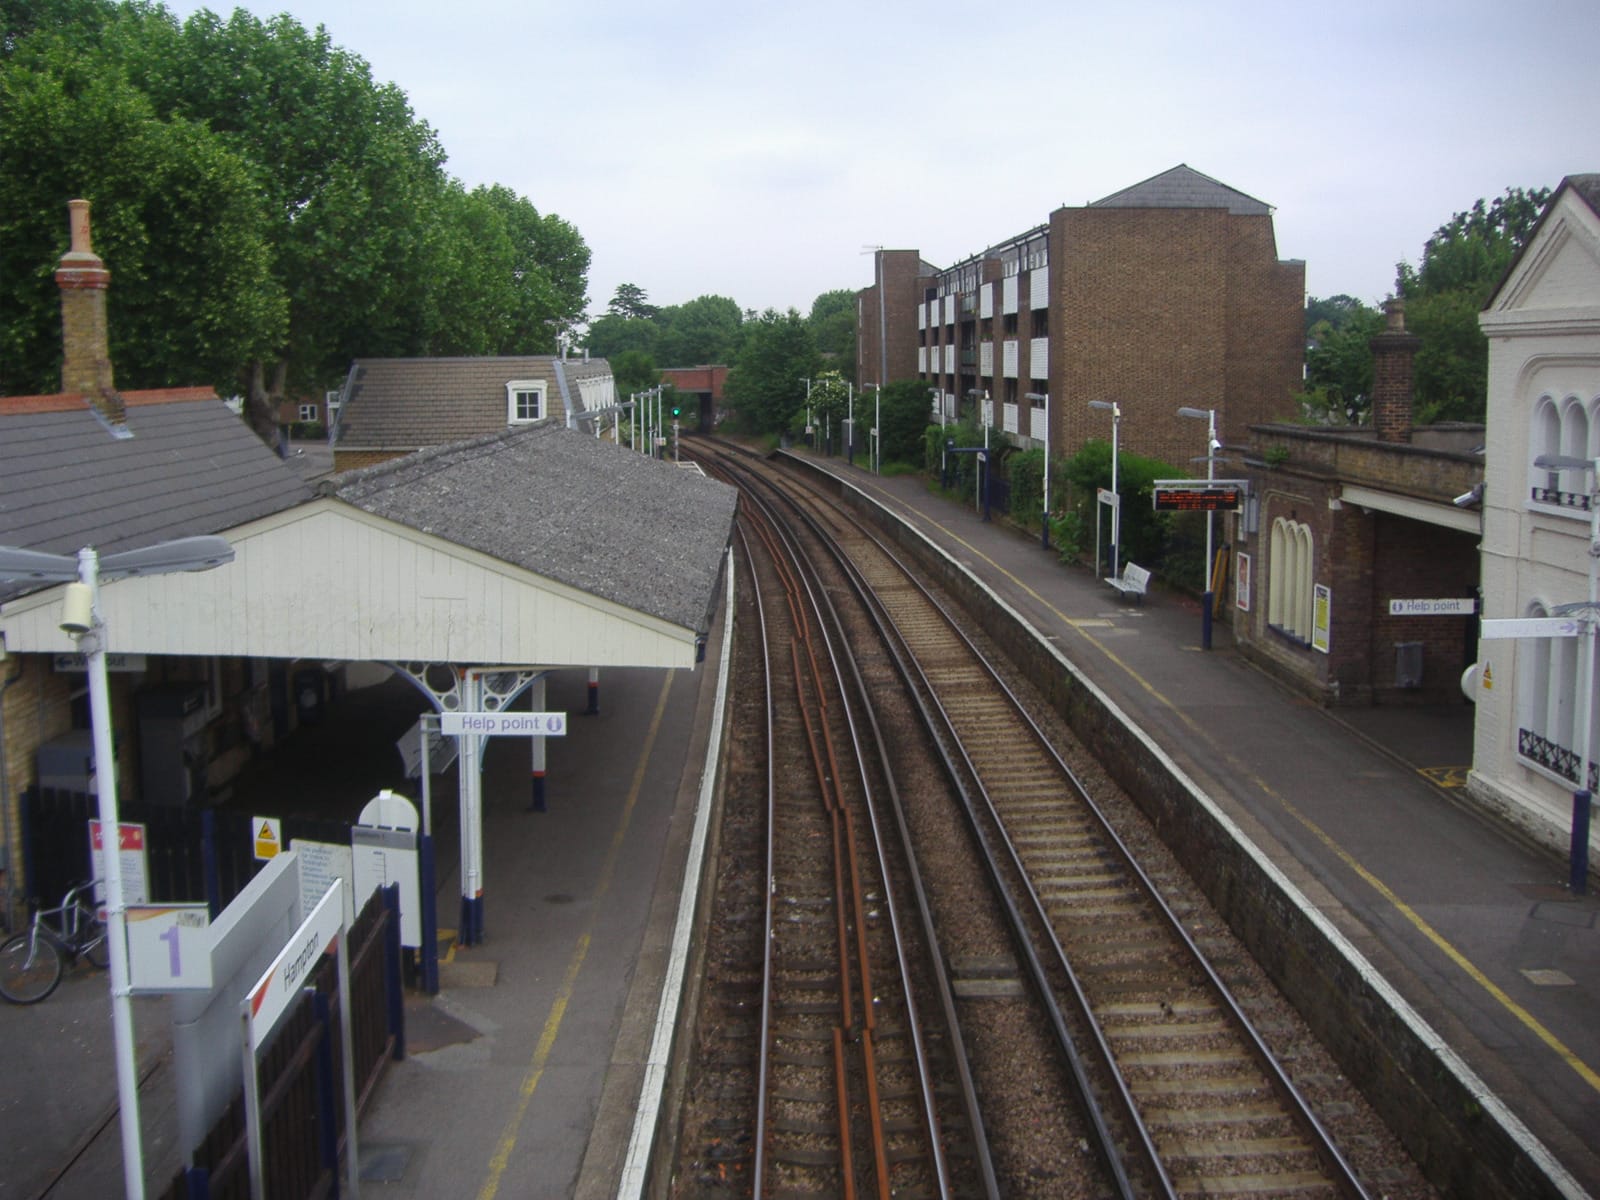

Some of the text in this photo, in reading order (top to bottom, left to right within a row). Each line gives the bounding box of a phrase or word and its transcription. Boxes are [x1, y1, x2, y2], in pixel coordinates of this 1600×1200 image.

[1407, 600, 1461, 611] Help point
[462, 717, 540, 731] Help point
[159, 926, 181, 978] 1
[283, 932, 319, 992] Hampton
